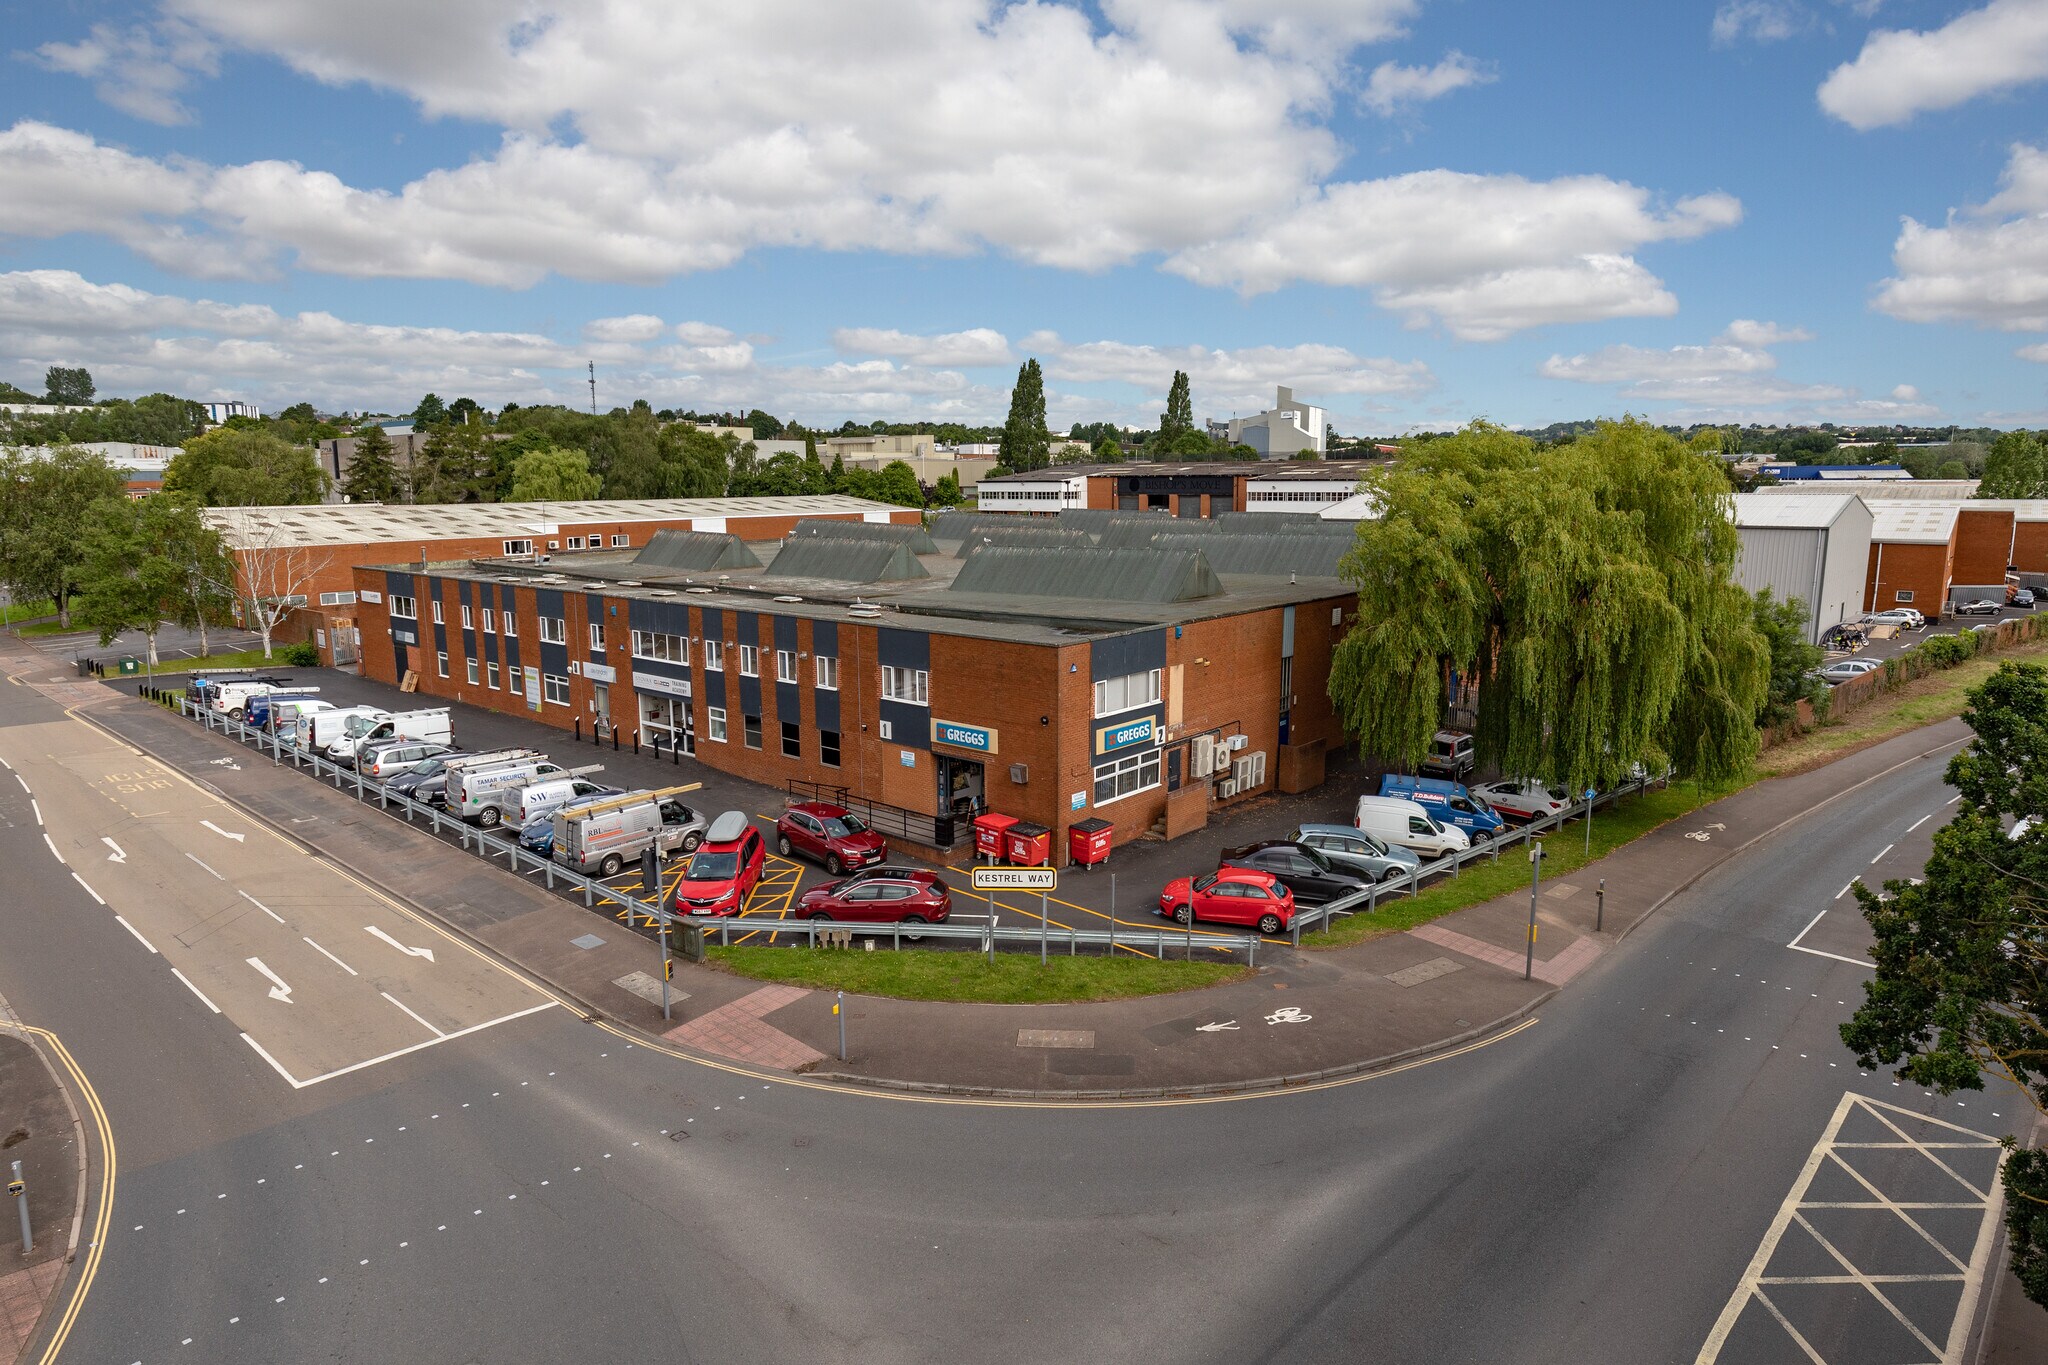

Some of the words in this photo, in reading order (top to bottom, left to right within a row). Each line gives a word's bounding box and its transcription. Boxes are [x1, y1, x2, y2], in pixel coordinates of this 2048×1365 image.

[1145, 480, 1187, 490] BISHOP'S
[1190, 480, 1220, 490] MOVE
[882, 723, 887, 737] 1
[946, 728, 985, 746] GREGGS
[1117, 723, 1150, 743] GREGGS
[1157, 728, 1164, 743] 2
[477, 777, 498, 785] TAMAR
[499, 772, 527, 782] SECURITY
[116, 779, 174, 794] BUS
[529, 791, 548, 804] SW
[978, 874, 1024, 883] KESTREL
[1028, 874, 1051, 883] WAY
